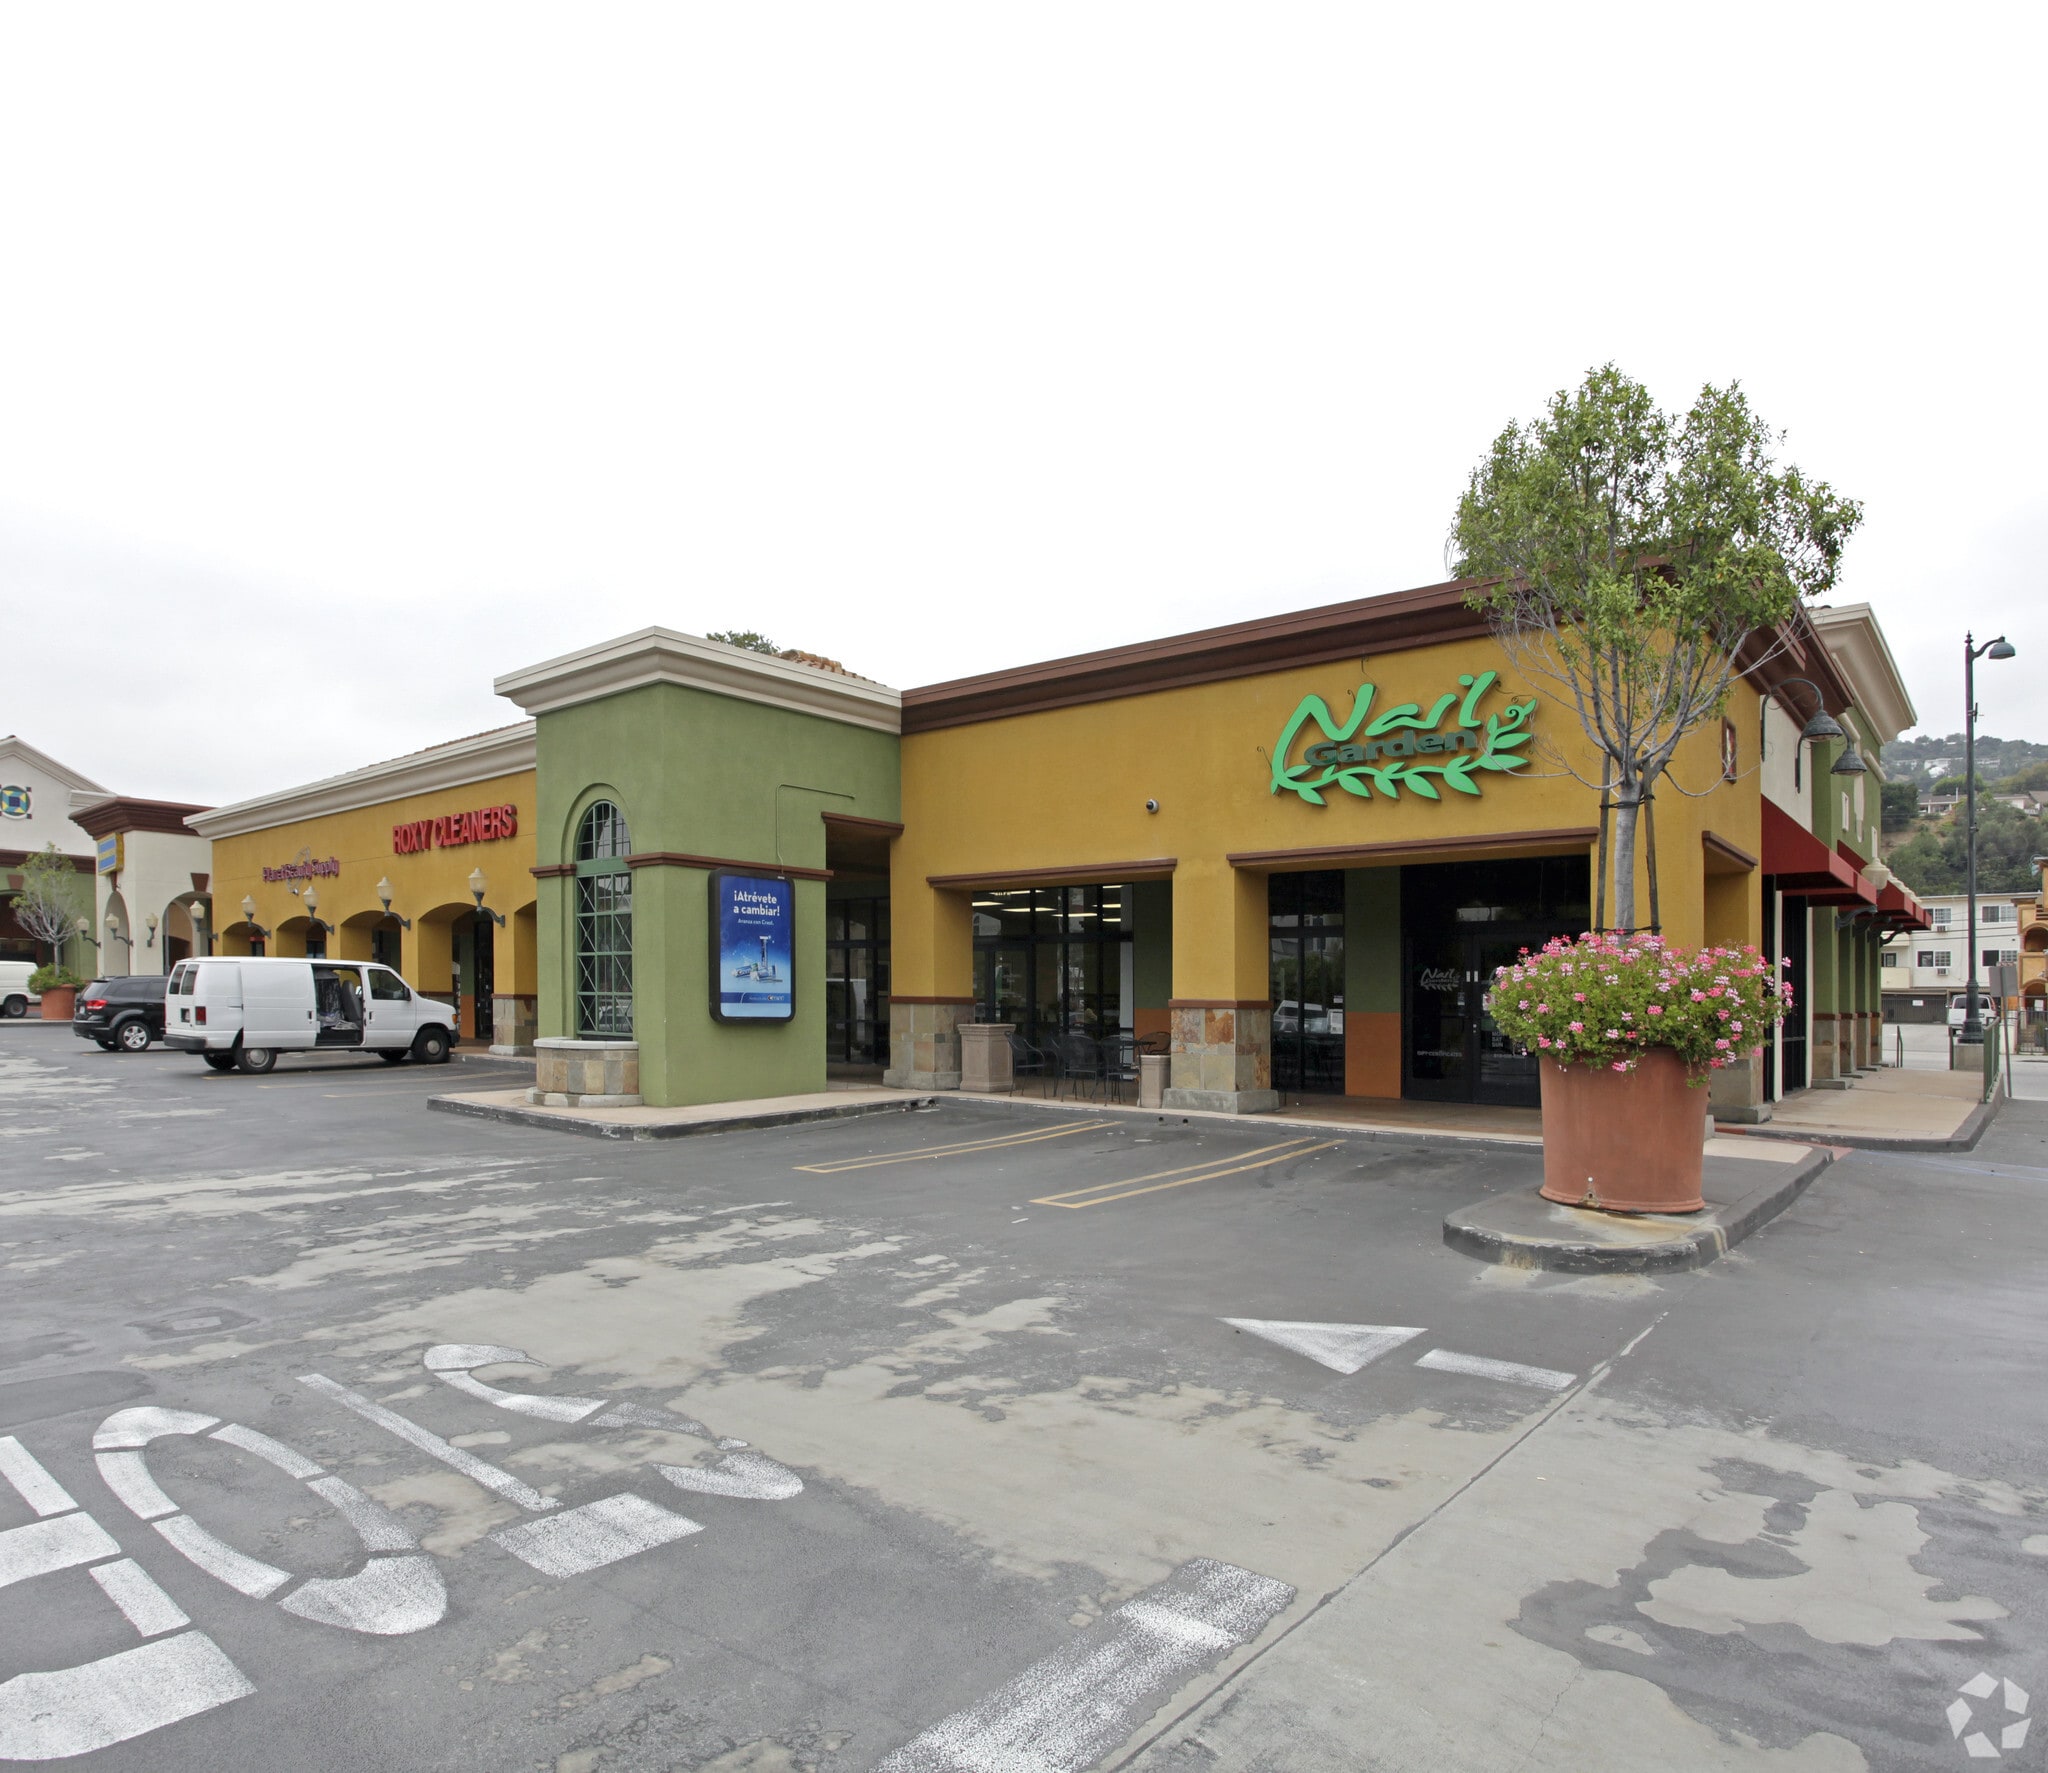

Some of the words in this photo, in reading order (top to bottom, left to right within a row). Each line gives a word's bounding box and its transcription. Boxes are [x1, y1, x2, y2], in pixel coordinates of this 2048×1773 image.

[1270, 670, 1499, 782] Nail
[1303, 729, 1478, 767] Garden
[392, 820, 433, 854] ROXY
[434, 804, 517, 848] CLEANERS
[312, 857, 339, 877] Supply
[733, 905, 740, 914] a
[741, 904, 780, 917] cambiar!
